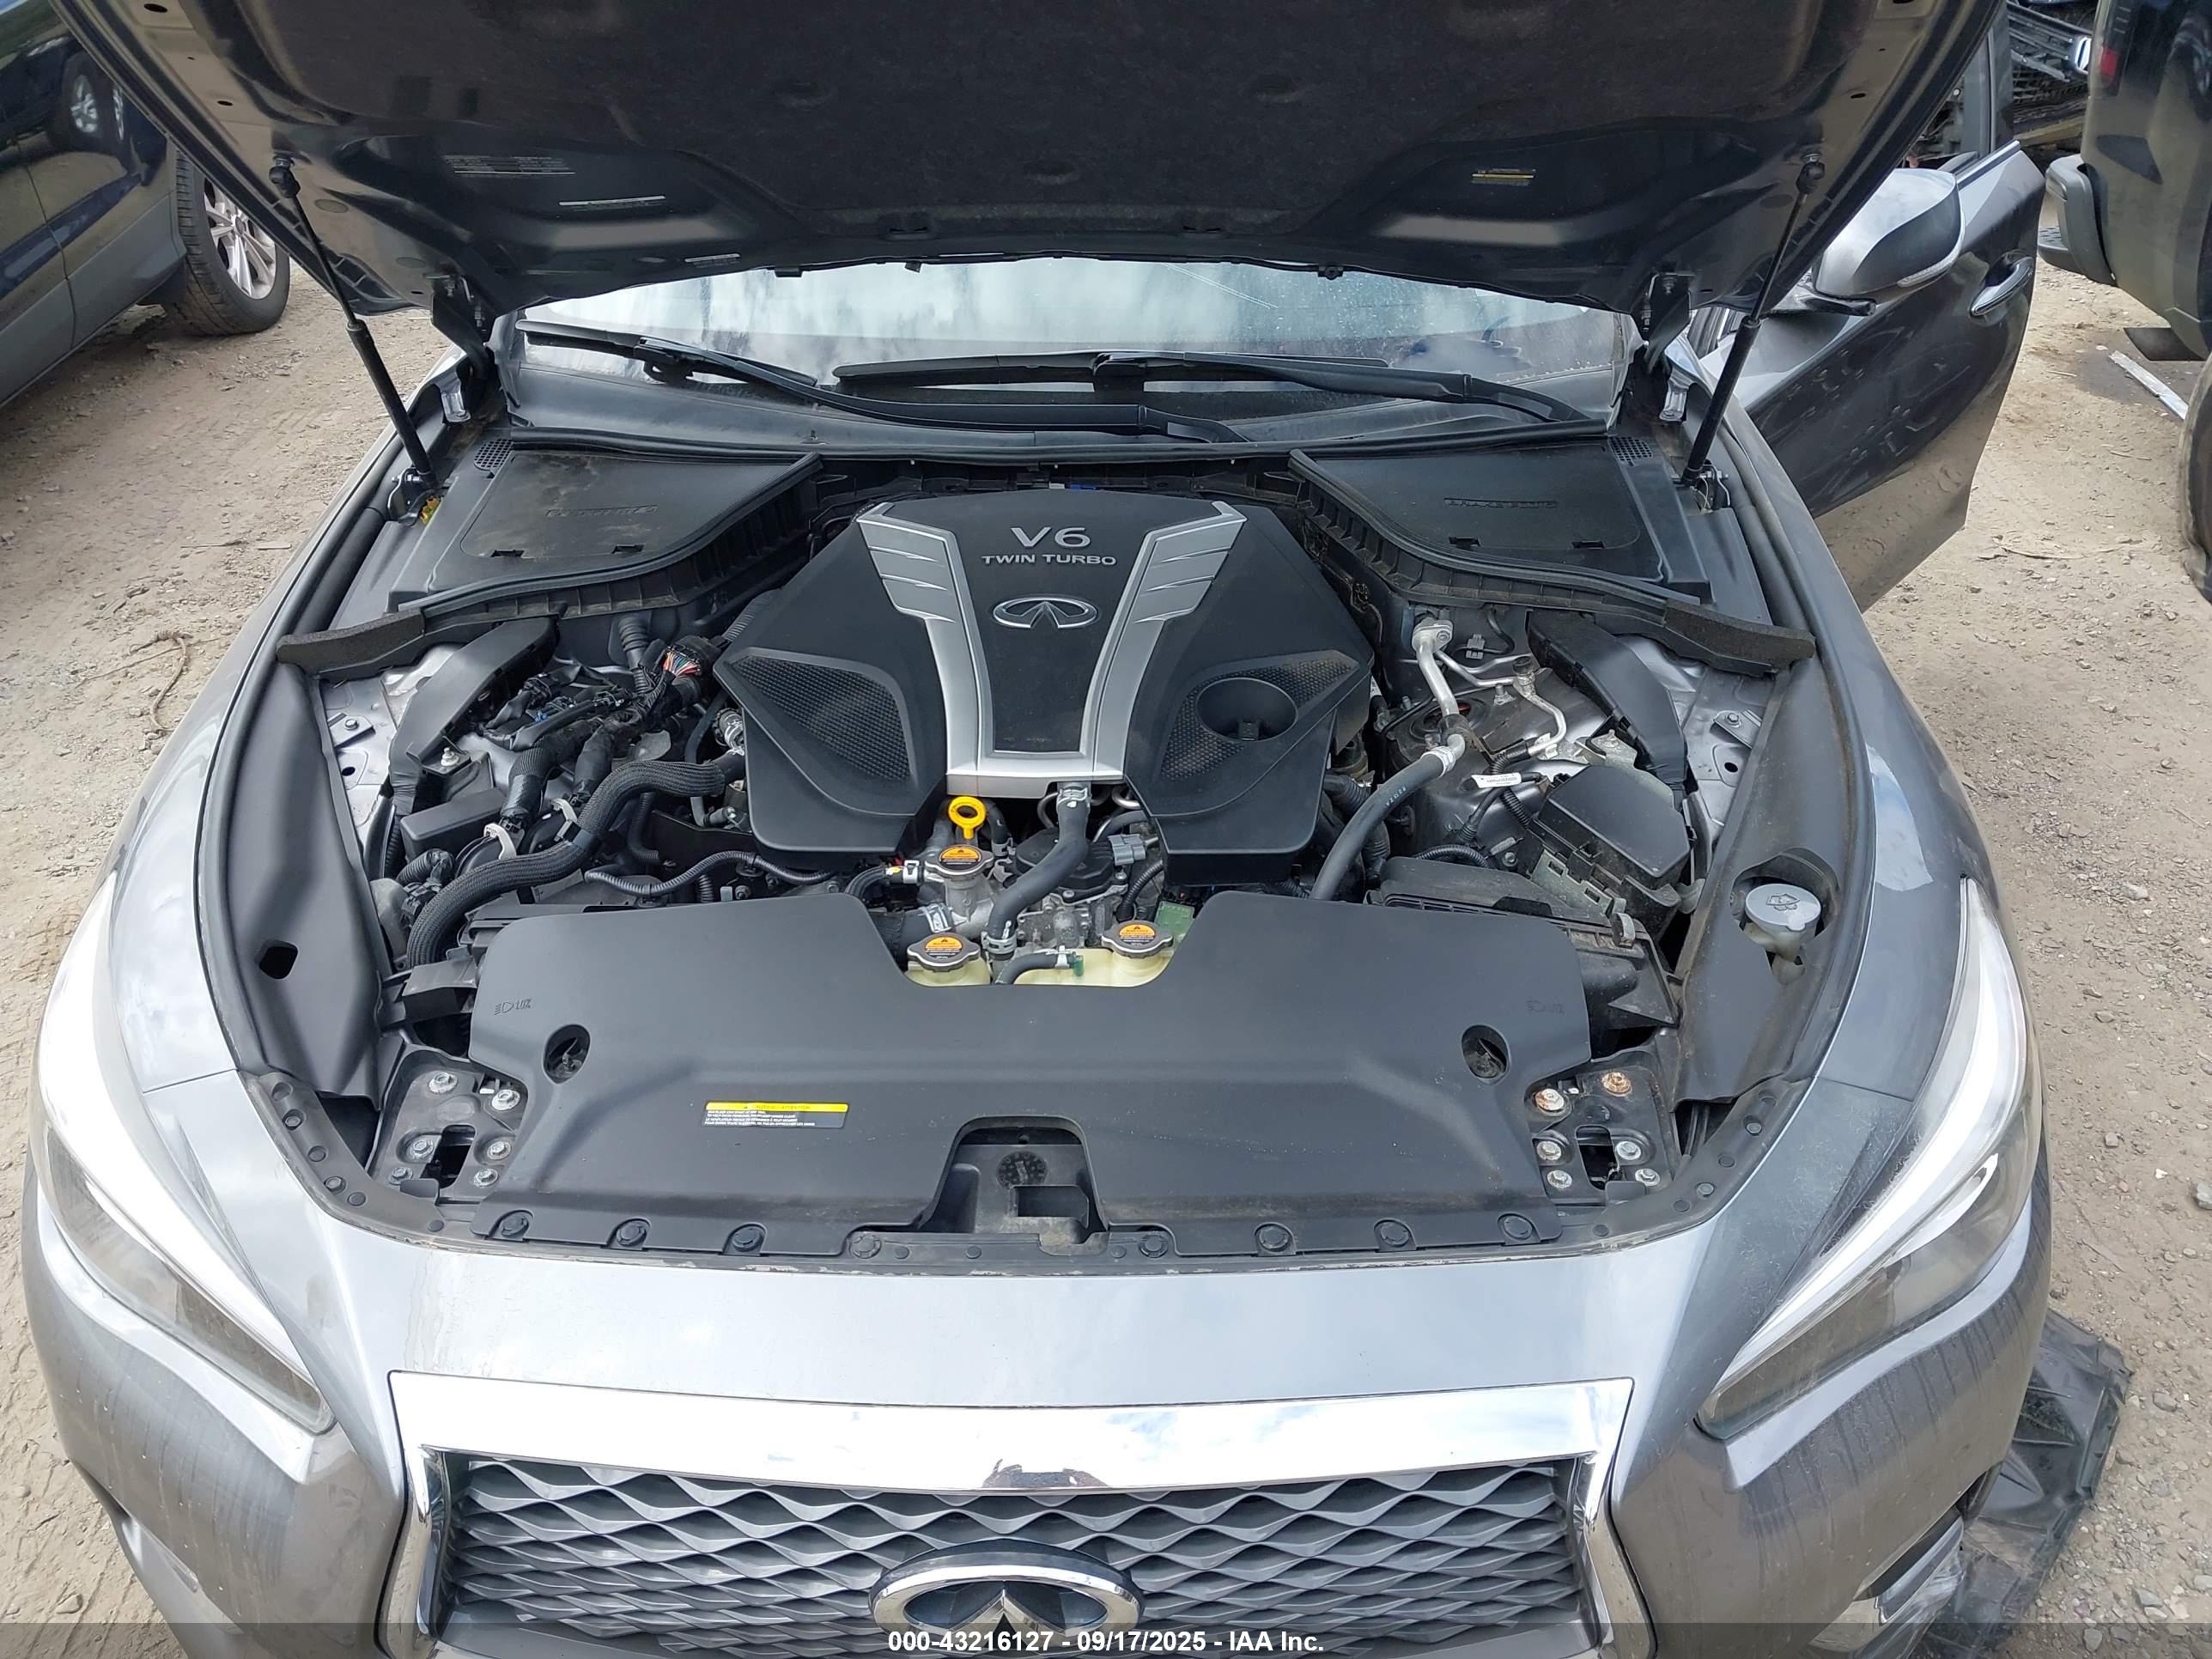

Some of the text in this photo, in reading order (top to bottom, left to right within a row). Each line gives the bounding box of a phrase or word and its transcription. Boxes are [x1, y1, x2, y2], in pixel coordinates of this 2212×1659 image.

[1010, 526, 1091, 548] V6
[981, 554, 1116, 566] TWIN TURBO
